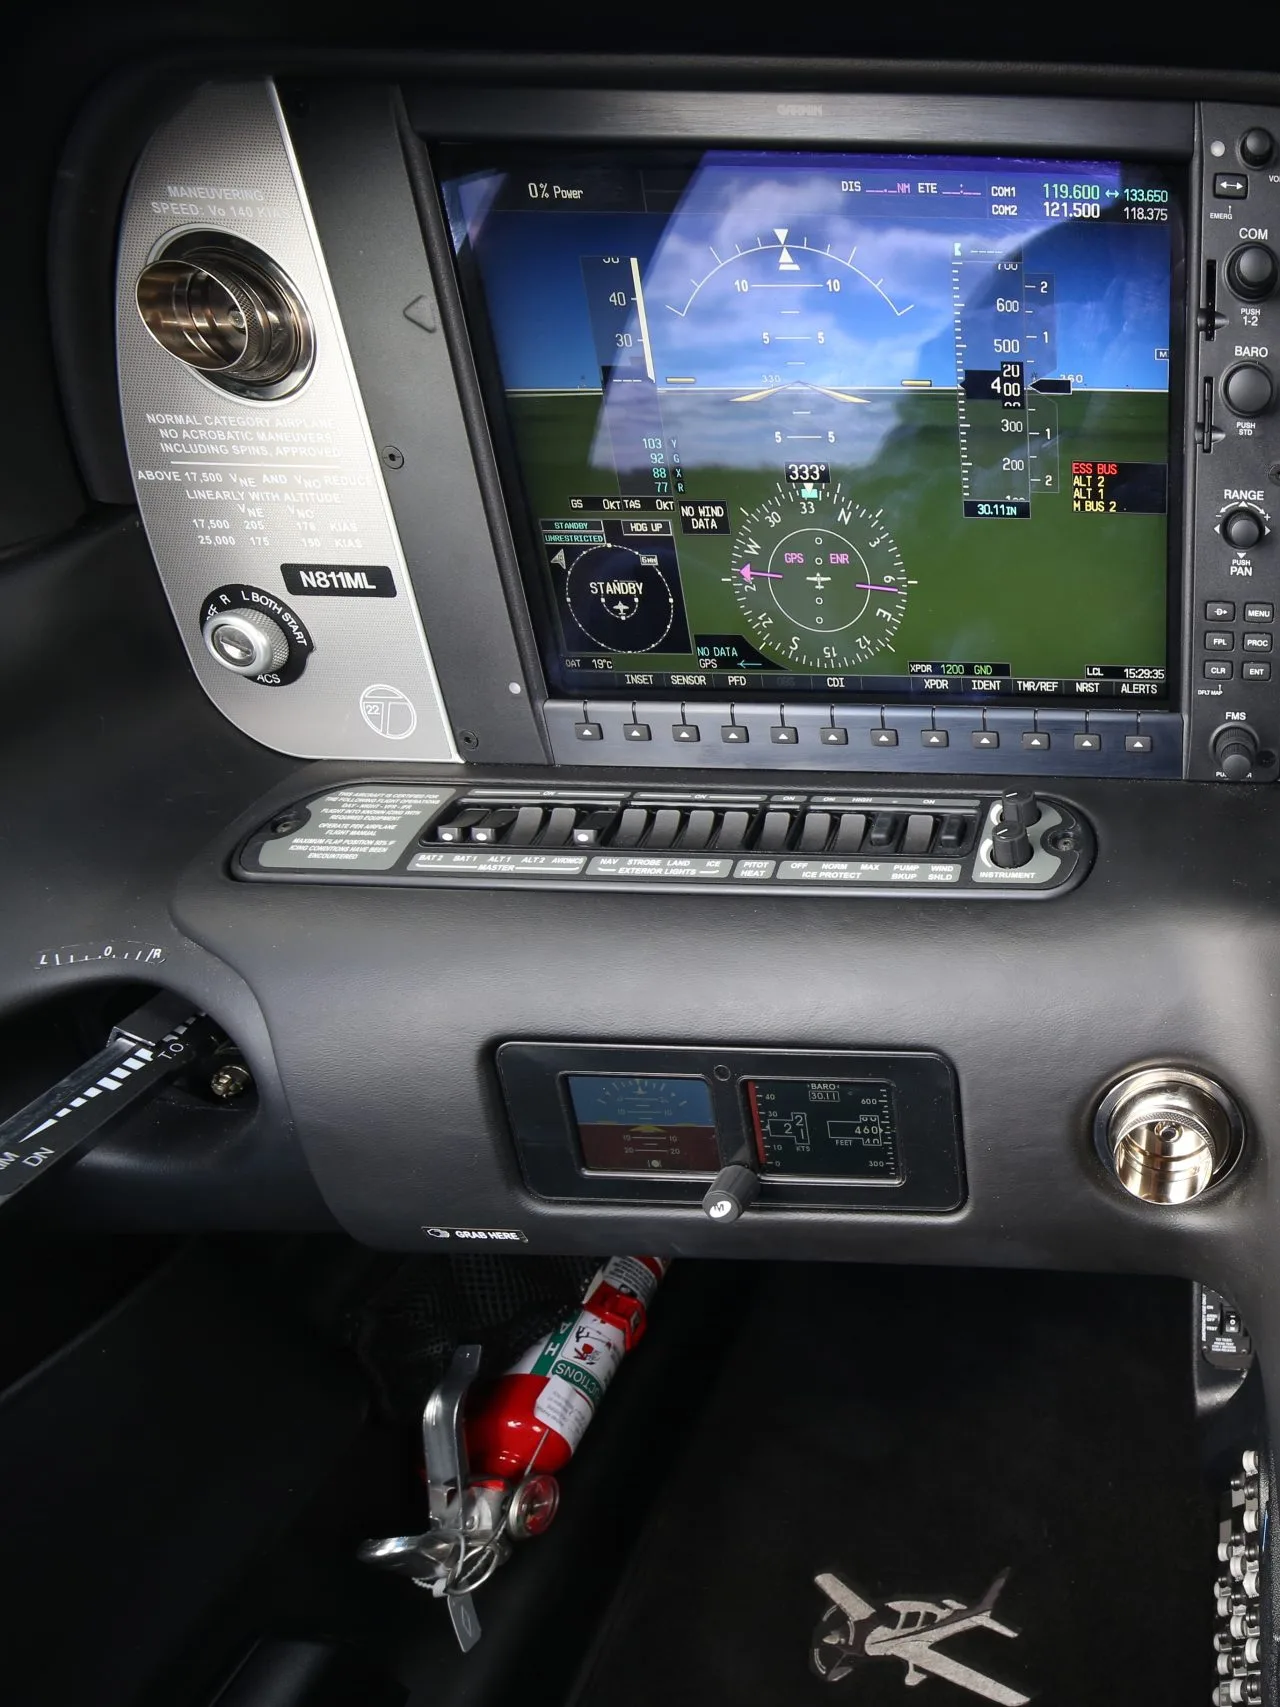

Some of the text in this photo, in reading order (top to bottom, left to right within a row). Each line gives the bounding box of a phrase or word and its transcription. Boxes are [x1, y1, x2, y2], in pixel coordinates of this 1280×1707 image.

[168, 186, 264, 201] MANEUVERING
[554, 186, 584, 199] Power
[918, 183, 937, 194] ETE
[992, 184, 1169, 202] COM1 119.600 133.650
[151, 202, 204, 215] SPEED:
[992, 202, 1168, 221] COM2 121.500 118.375
[1239, 228, 1268, 240] COM
[996, 299, 1019, 312] 600
[994, 339, 1020, 353] 500
[1235, 346, 1268, 357] BARO
[146, 414, 271, 427] NORMAL CATEGORY
[1001, 420, 1023, 432] 300
[160, 429, 253, 441] NO ACROBATIC
[160, 443, 229, 455] INCLUDING
[1002, 459, 1024, 470] 200
[1073, 464, 1117, 474] ESS BUS
[138, 470, 287, 484] ABOVE 17,500 AND
[1073, 477, 1104, 487] ALT 2
[186, 490, 341, 503] LINEARLY WITH ALTITUDE
[1074, 489, 1092, 499] ALT
[1224, 489, 1264, 500] RANGE
[624, 500, 641, 508] TAS
[1085, 501, 1116, 512] BUS 2
[681, 506, 724, 517] NO WIND
[554, 522, 662, 532] STANDBY HDG UP
[692, 518, 717, 529] DATA
[198, 536, 235, 546] 25,000
[784, 553, 849, 564] GPS ENR
[1230, 567, 1252, 576] PAN
[300, 571, 376, 589] N811ML
[590, 582, 643, 594] STANDBY
[252, 592, 283, 614] BOTH
[282, 613, 307, 646] START
[1213, 638, 1268, 647] FPL PROC
[697, 647, 738, 656] NO DATA
[699, 660, 717, 668] GPS
[940, 664, 992, 675] 1200 GND
[1124, 668, 1164, 679] 15:29:35
[1250, 668, 1264, 676] ENT
[257, 674, 281, 684] ACS
[625, 675, 653, 684] INSET
[671, 675, 707, 685] SENSOR
[728, 676, 746, 686] PFD
[827, 678, 845, 687] CDI
[972, 680, 1001, 691] IDENT
[1017, 681, 1058, 692] TMR/REF
[1076, 682, 1100, 693] NRST
[1121, 684, 1157, 694] ALERTS
[1226, 712, 1246, 720] FMS
[455, 1230, 520, 1240] GRAB HERE
